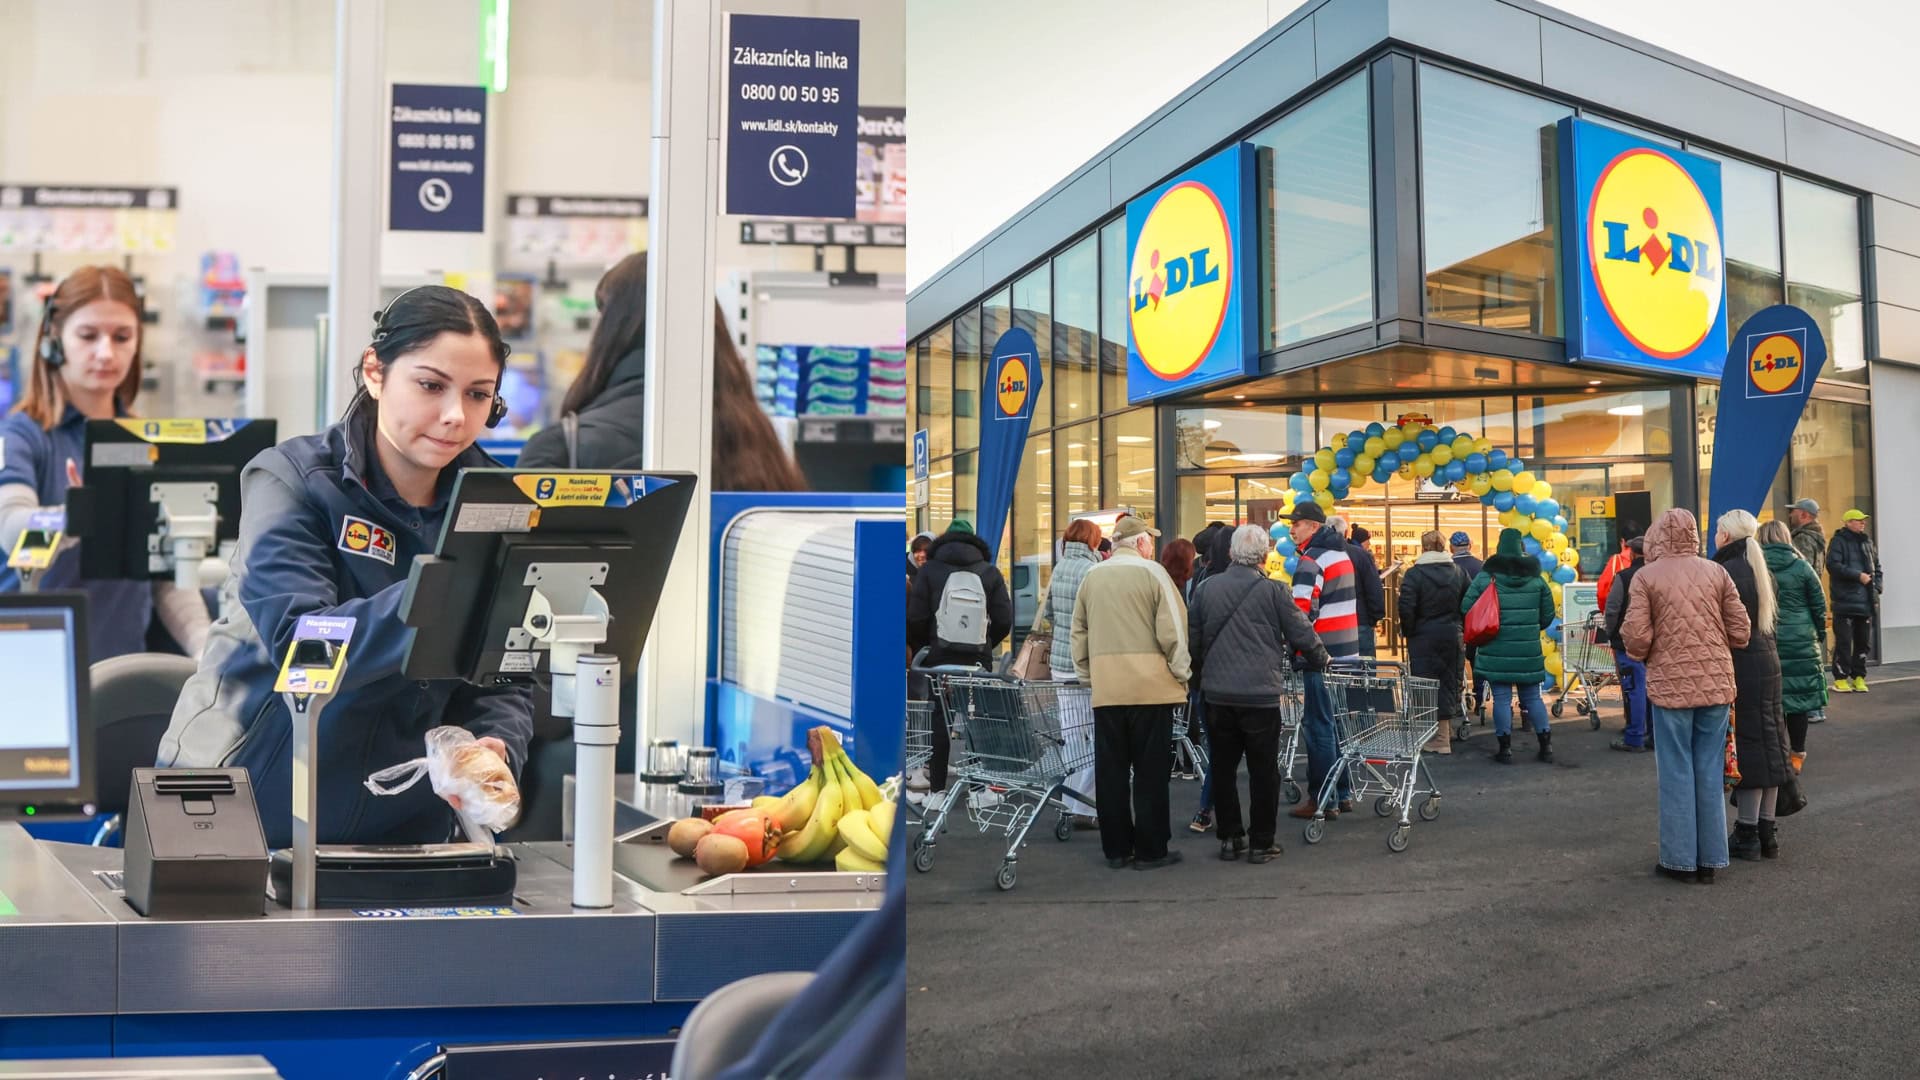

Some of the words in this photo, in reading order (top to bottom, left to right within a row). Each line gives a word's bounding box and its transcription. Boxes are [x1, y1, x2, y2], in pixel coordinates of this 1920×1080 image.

[733, 47, 810, 68] Zákaznícka
[815, 51, 848, 69] linka
[741, 84, 776, 100] 0800
[780, 85, 798, 101] 00
[801, 87, 818, 102] 50
[822, 88, 839, 103] 95
[741, 119, 839, 137] www.lidl.sk/kontakty
